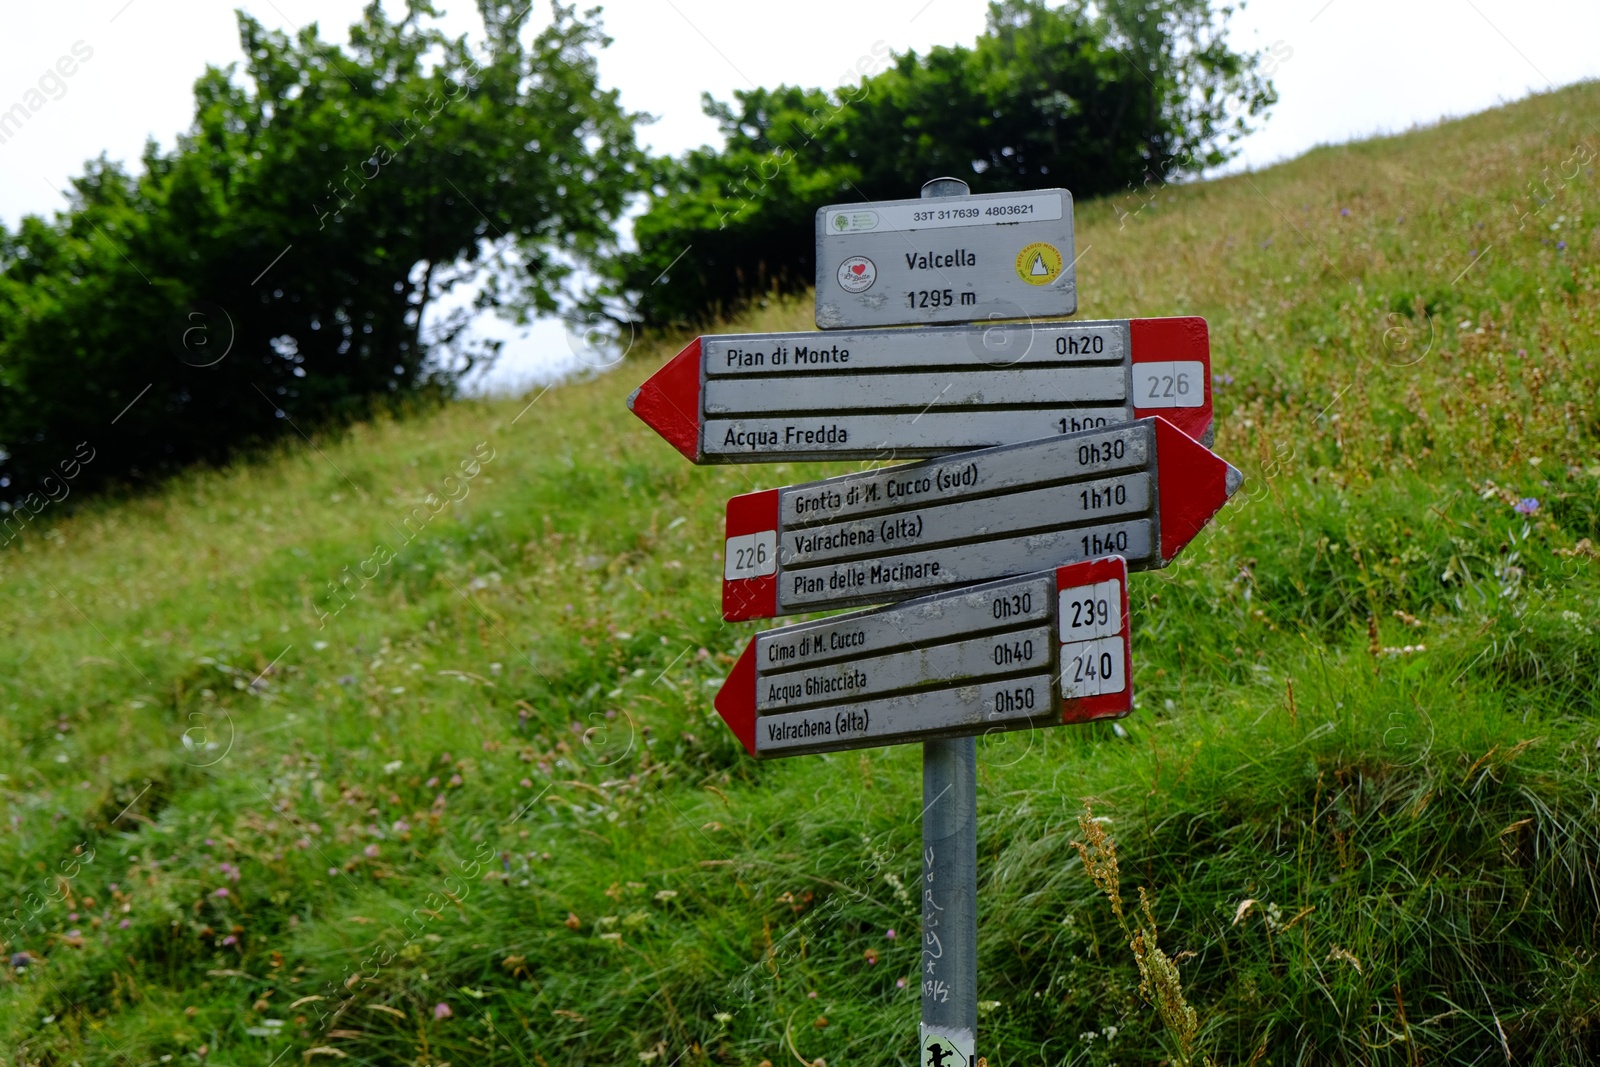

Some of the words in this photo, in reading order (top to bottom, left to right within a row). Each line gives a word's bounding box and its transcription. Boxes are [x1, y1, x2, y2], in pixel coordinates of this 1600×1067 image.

[913, 210, 935, 222] 33T
[937, 208, 980, 220] 317639
[985, 204, 1034, 217] 4803621
[906, 249, 976, 270] Valcella
[907, 289, 953, 309] 1295
[960, 291, 976, 306] m
[727, 349, 764, 367] Pian
[771, 347, 787, 366] di
[795, 345, 850, 365] Monte
[1056, 335, 1104, 355] 0h20
[1148, 372, 1190, 399] 226
[723, 428, 778, 450] Acqua
[785, 424, 848, 445] Fredda
[795, 490, 842, 514] Grotta
[846, 486, 859, 506] di
[864, 482, 881, 503] M.
[887, 479, 930, 499] Cucco
[936, 463, 979, 492] (sud)
[1078, 439, 1124, 465] 0h30
[794, 526, 875, 554] Valrachena
[880, 515, 923, 543] (alta)
[1080, 485, 1126, 510] 1h10
[735, 542, 767, 570] 226
[794, 575, 824, 595] Pian
[829, 567, 865, 590] delle
[870, 560, 940, 585] Macinare
[1081, 531, 1127, 556] 1h40
[768, 642, 796, 662] Cima
[799, 637, 810, 656] di
[814, 634, 827, 653] M.
[830, 630, 865, 651] Cucco
[993, 592, 1031, 619] 0h30
[1071, 599, 1108, 628] 239
[768, 683, 802, 704] Acqua
[805, 669, 867, 696] Ghiacciata
[994, 639, 1033, 665] 0h40
[1072, 652, 1112, 683] 240
[768, 718, 831, 742] Valrachena
[835, 708, 870, 735] (alta)
[995, 687, 1034, 713] 0h50
